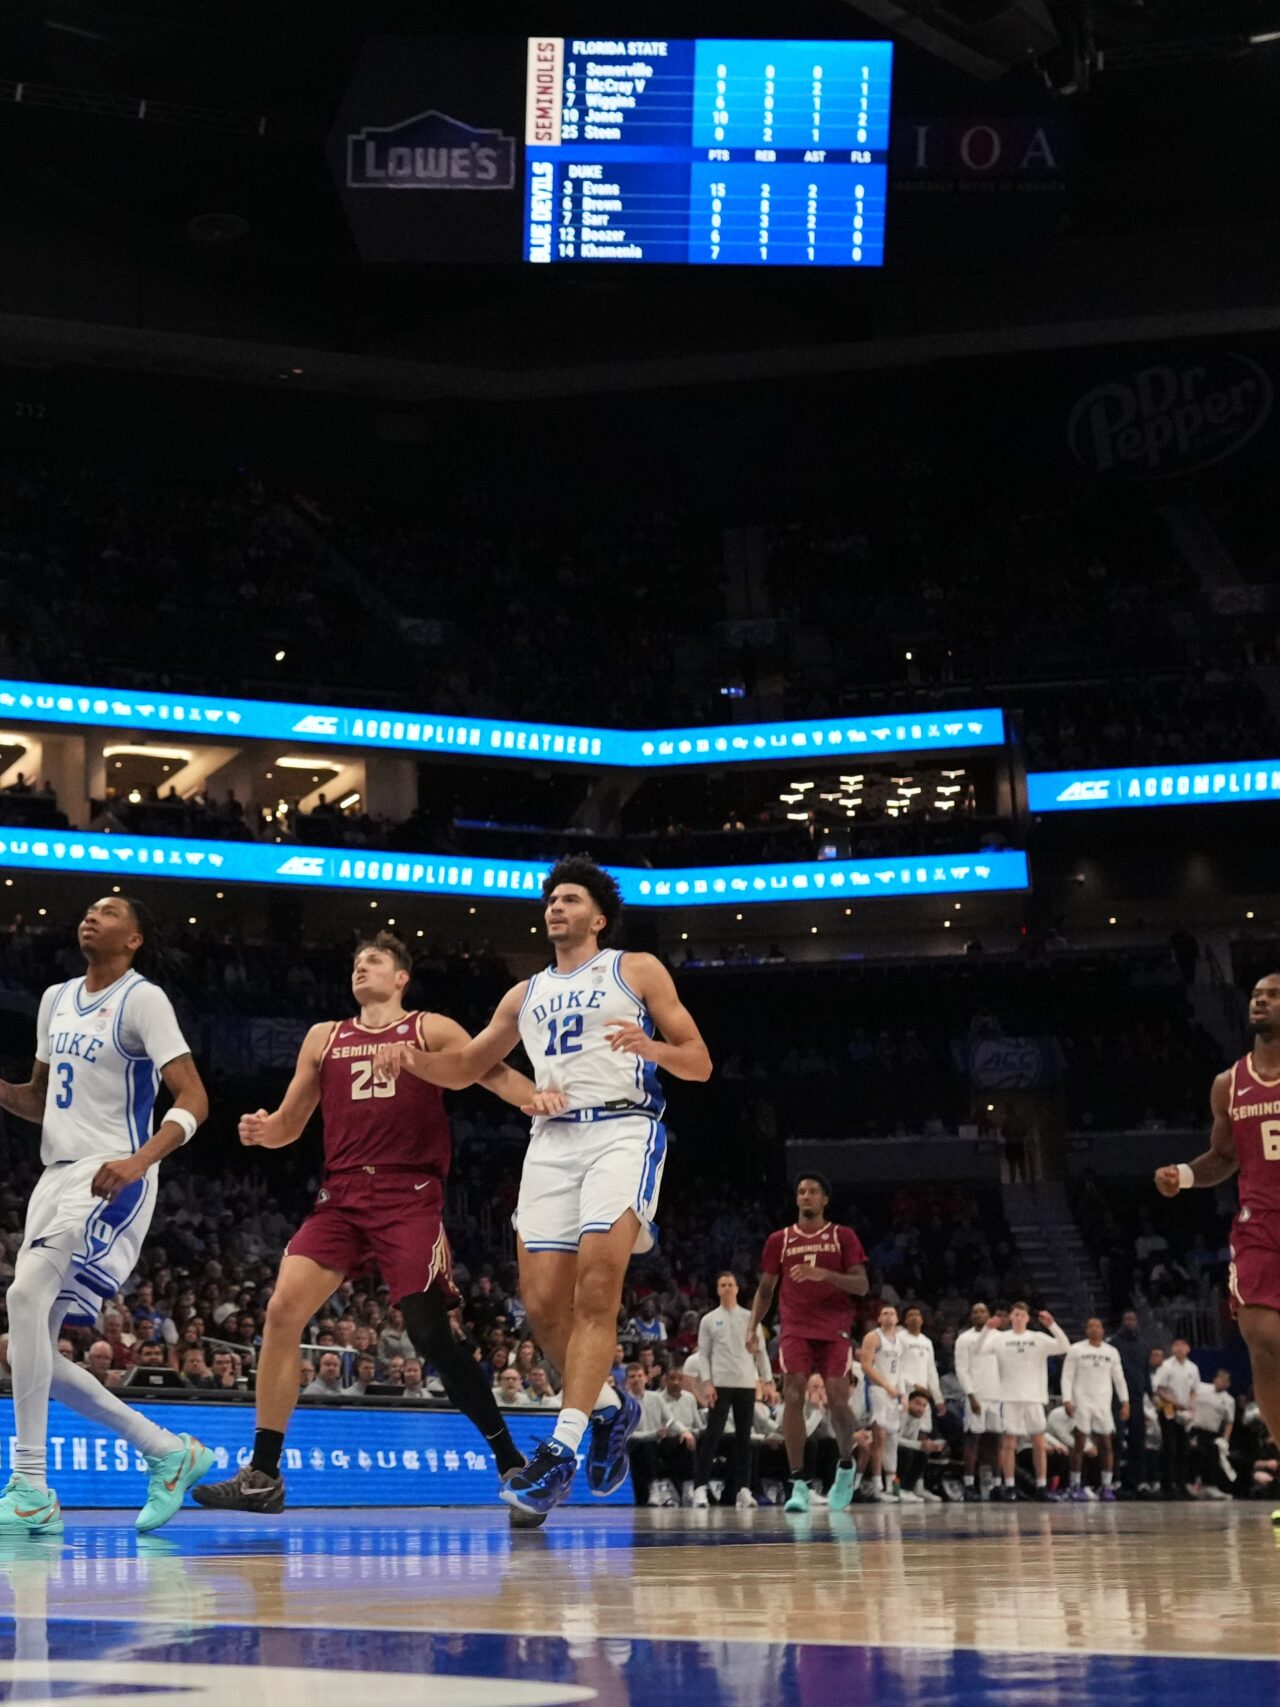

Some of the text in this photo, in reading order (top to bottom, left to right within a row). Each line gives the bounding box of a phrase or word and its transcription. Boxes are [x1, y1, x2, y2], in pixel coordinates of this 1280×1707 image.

[572, 40, 668, 56] FLORIDA STATE
[567, 62, 576, 76] 1
[861, 66, 869, 80] 1
[535, 42, 555, 141] SEMINOLES
[566, 78, 576, 92] 6
[635, 78, 646, 93] V
[861, 82, 868, 96] 1
[566, 93, 576, 107] 7
[813, 96, 821, 111] 1
[860, 97, 868, 111] 1
[563, 108, 579, 122] 10
[813, 112, 820, 126] 1
[562, 125, 578, 139] 25
[812, 128, 819, 142] 1
[365, 140, 498, 180] LOWE'S
[708, 149, 730, 162] PTS
[804, 150, 826, 163] AST
[568, 164, 603, 178] DUKE
[563, 180, 573, 195] 3
[710, 183, 726, 197] 15
[761, 183, 770, 198] 2
[808, 184, 817, 199] 2
[530, 162, 553, 263] BLUE DEVILS
[808, 200, 817, 214] 2
[856, 200, 863, 214] 1
[562, 212, 572, 225] 7
[760, 214, 769, 229] 3
[807, 214, 816, 229] 2
[559, 227, 575, 241] 12
[759, 230, 768, 244] 3
[808, 231, 815, 245] 1
[558, 243, 574, 257] 14
[710, 245, 720, 260] 7
[760, 246, 767, 260] 1
[807, 247, 814, 261] 1
[1078, 379, 1256, 472] Pepper
[352, 718, 481, 746] ACCOMPLISH
[490, 730, 602, 756] GREATNESS
[1056, 780, 1111, 801] ACC
[339, 859, 473, 886] ACCOMPLISH
[531, 989, 607, 1025] DUKE
[544, 1013, 584, 1057] 12
[56, 1062, 74, 1110] 3
[1260, 1119, 1280, 1161] 6
[786, 1243, 836, 1257] SEMINOLES
